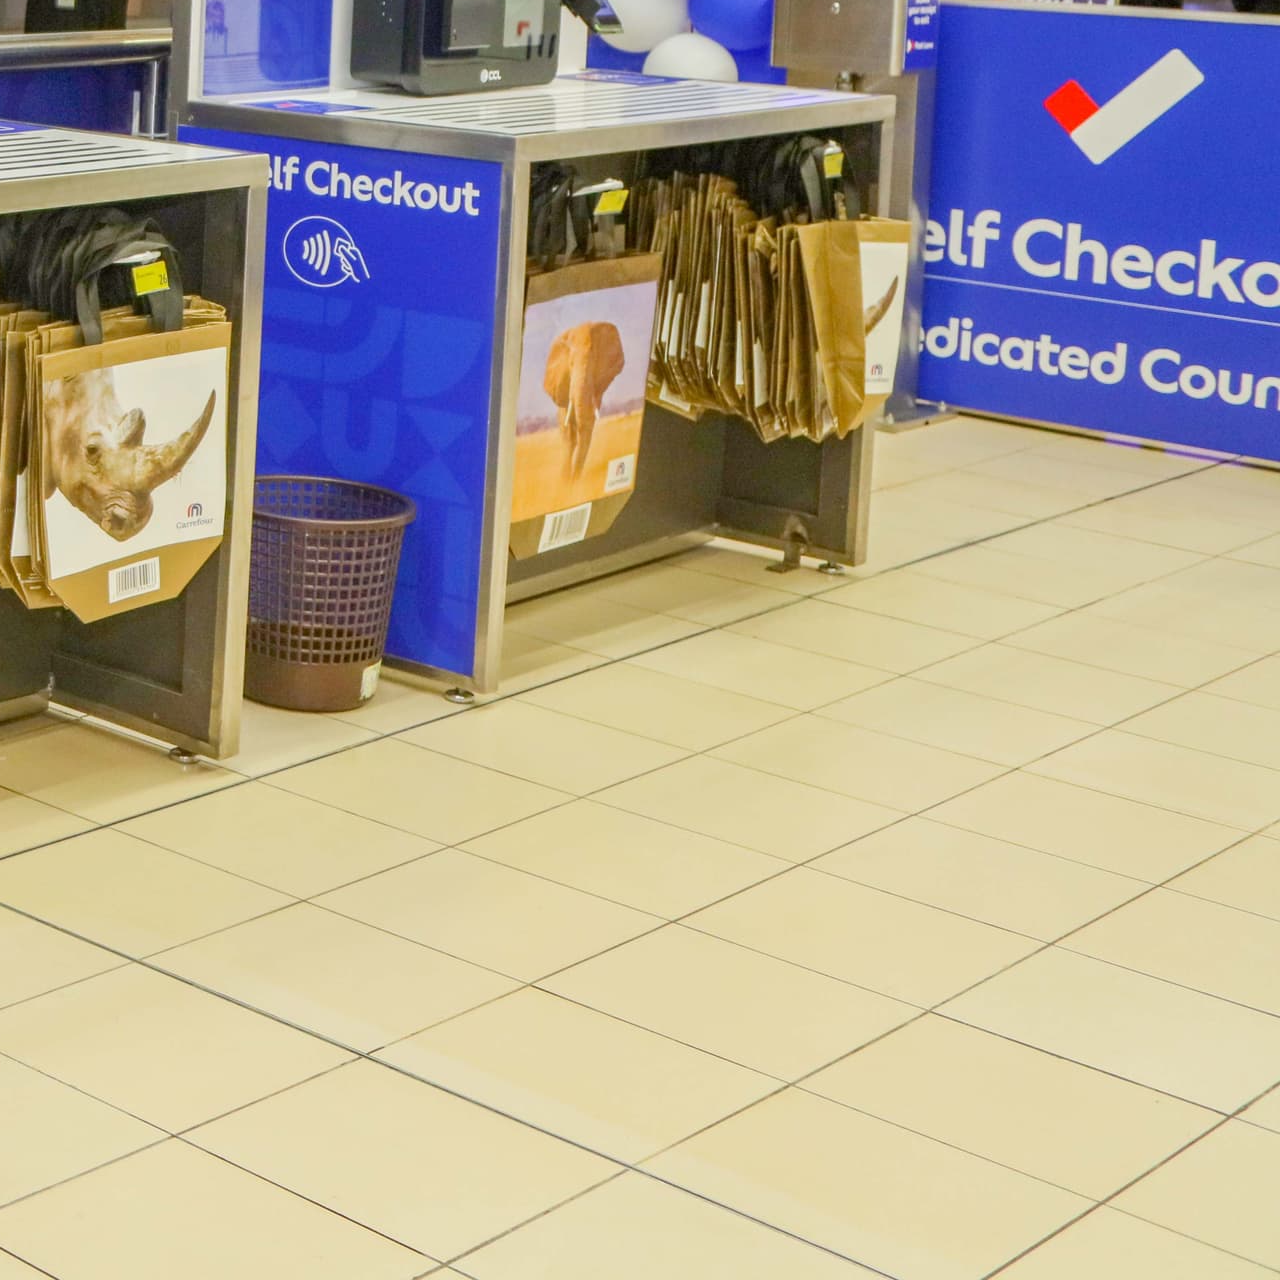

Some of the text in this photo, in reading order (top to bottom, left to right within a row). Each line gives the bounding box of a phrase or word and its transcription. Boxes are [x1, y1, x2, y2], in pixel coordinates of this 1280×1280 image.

[305, 160, 480, 217] Checkout
[917, 318, 1127, 385] dicated
[176, 518, 213, 528] Carrefour
